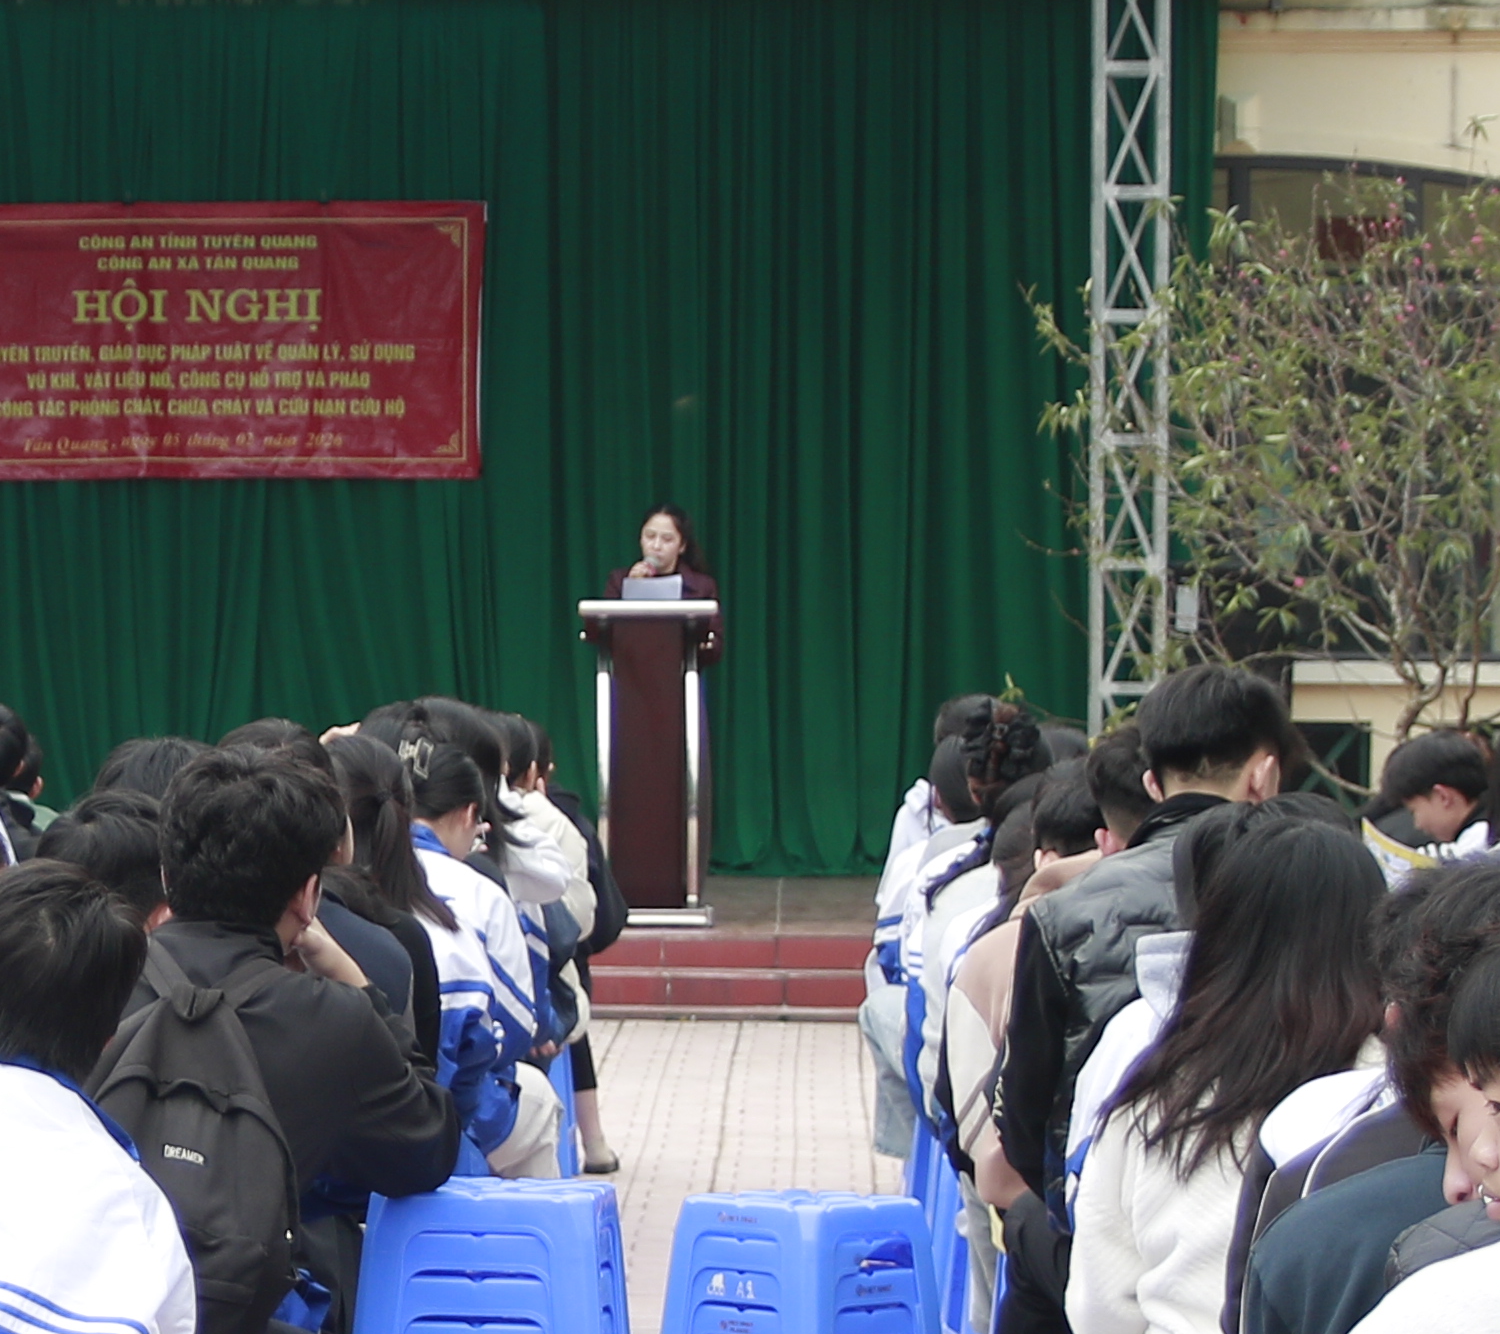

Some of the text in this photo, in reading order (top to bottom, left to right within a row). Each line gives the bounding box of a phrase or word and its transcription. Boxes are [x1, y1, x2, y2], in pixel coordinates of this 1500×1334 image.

[79, 234, 125, 250] CÔNG
[130, 236, 154, 249] AN
[203, 233, 257, 249] TUYÊN
[260, 235, 318, 250] QUANG
[97, 255, 144, 271] CÔNG
[148, 256, 172, 270] AN
[205, 255, 238, 270] TÂN
[242, 255, 299, 271] QUANG
[72, 277, 322, 332] HỘI NGHỊ
[99, 342, 133, 362] GIÁO
[136, 344, 167, 364] DỤC
[171, 342, 211, 362] PHÁP
[215, 340, 251, 363] LUẬT
[374, 343, 415, 364] DỤNG
[84, 370, 111, 390] VẬT
[115, 370, 146, 390] LIỆU
[179, 369, 221, 389] CÔNG
[225, 371, 246, 390] CỤ
[37, 397, 65, 417] TÁC
[69, 396, 121, 416] PHÒNG
[212, 396, 251, 415] CHÁY
[256, 396, 274, 415] VÀ
[313, 398, 346, 417] NẠN
[350, 395, 381, 415] CỨU
[385, 395, 405, 418] HỘ
[186, 432, 230, 451] tháng
[305, 433, 343, 447] 2026
